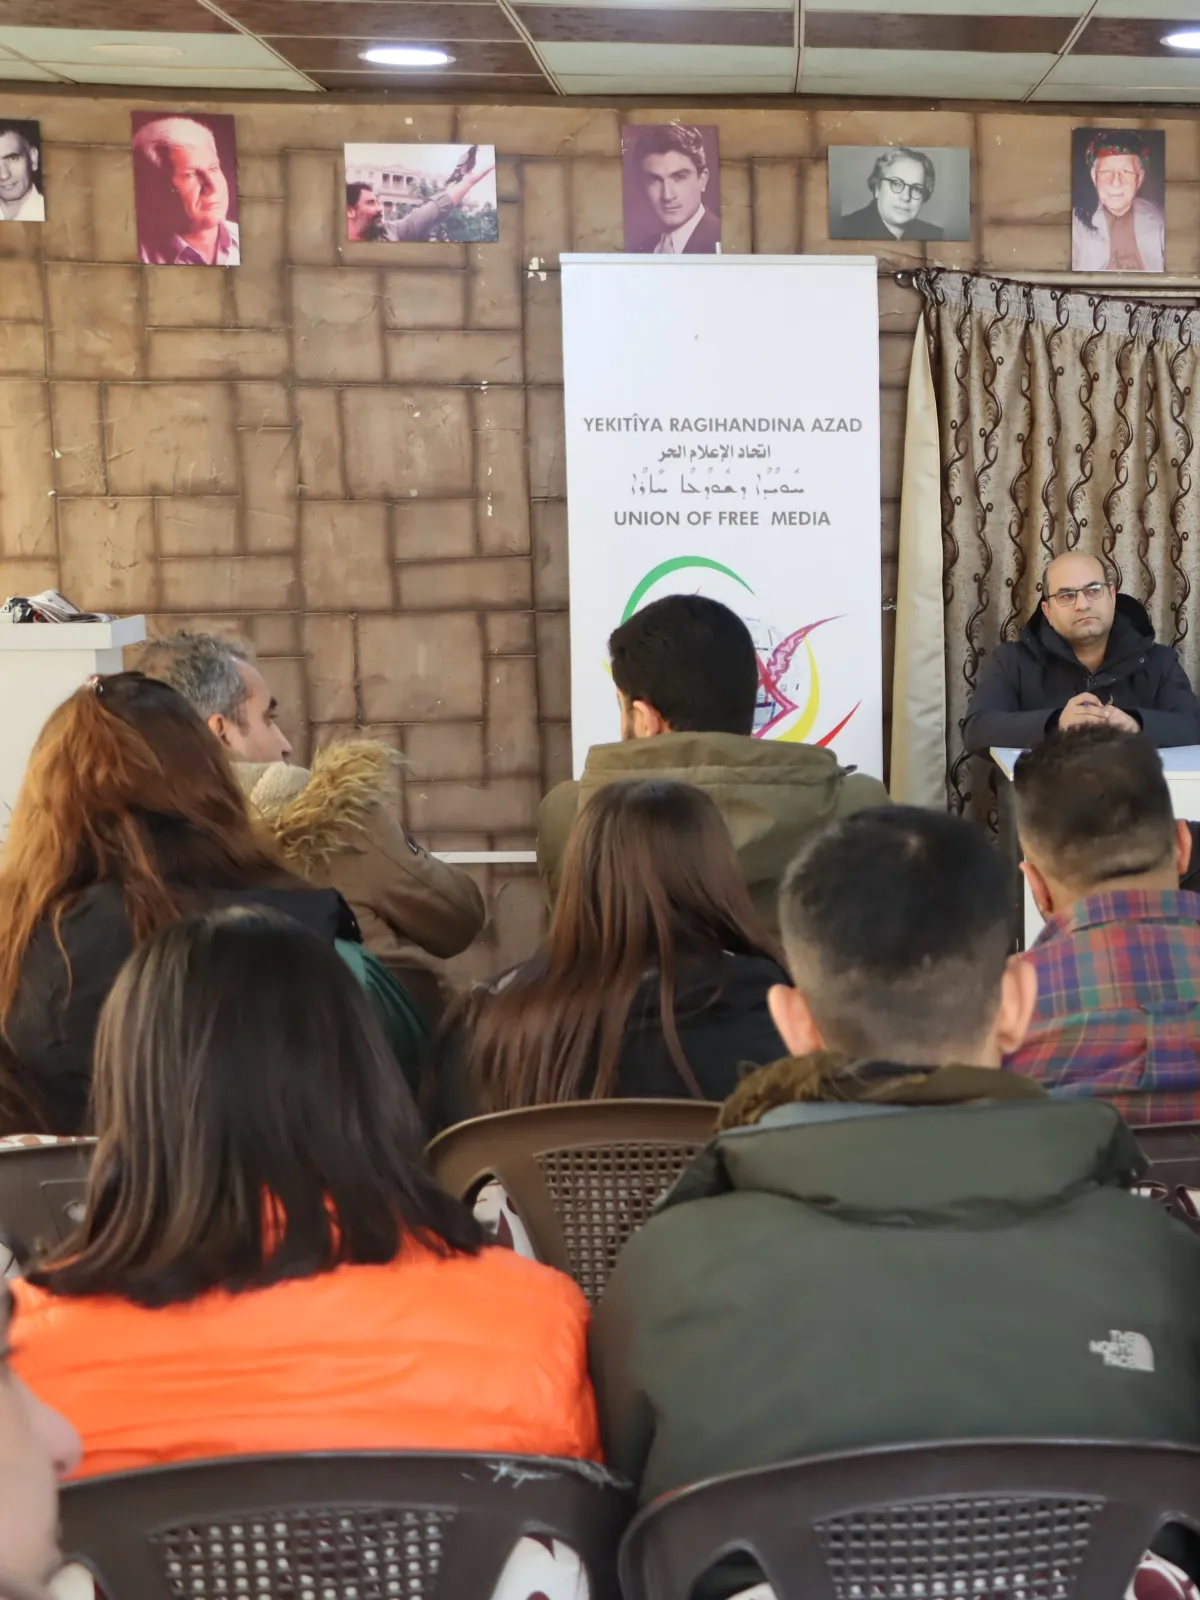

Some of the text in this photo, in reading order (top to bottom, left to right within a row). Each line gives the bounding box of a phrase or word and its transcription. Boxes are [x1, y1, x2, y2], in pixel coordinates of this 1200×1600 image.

[583, 412, 863, 433] YEKITÎYA RAGIHANDINA AZAD
[657, 444, 687, 463] الحر
[614, 510, 831, 526] UNION OF FREE MEDIA
